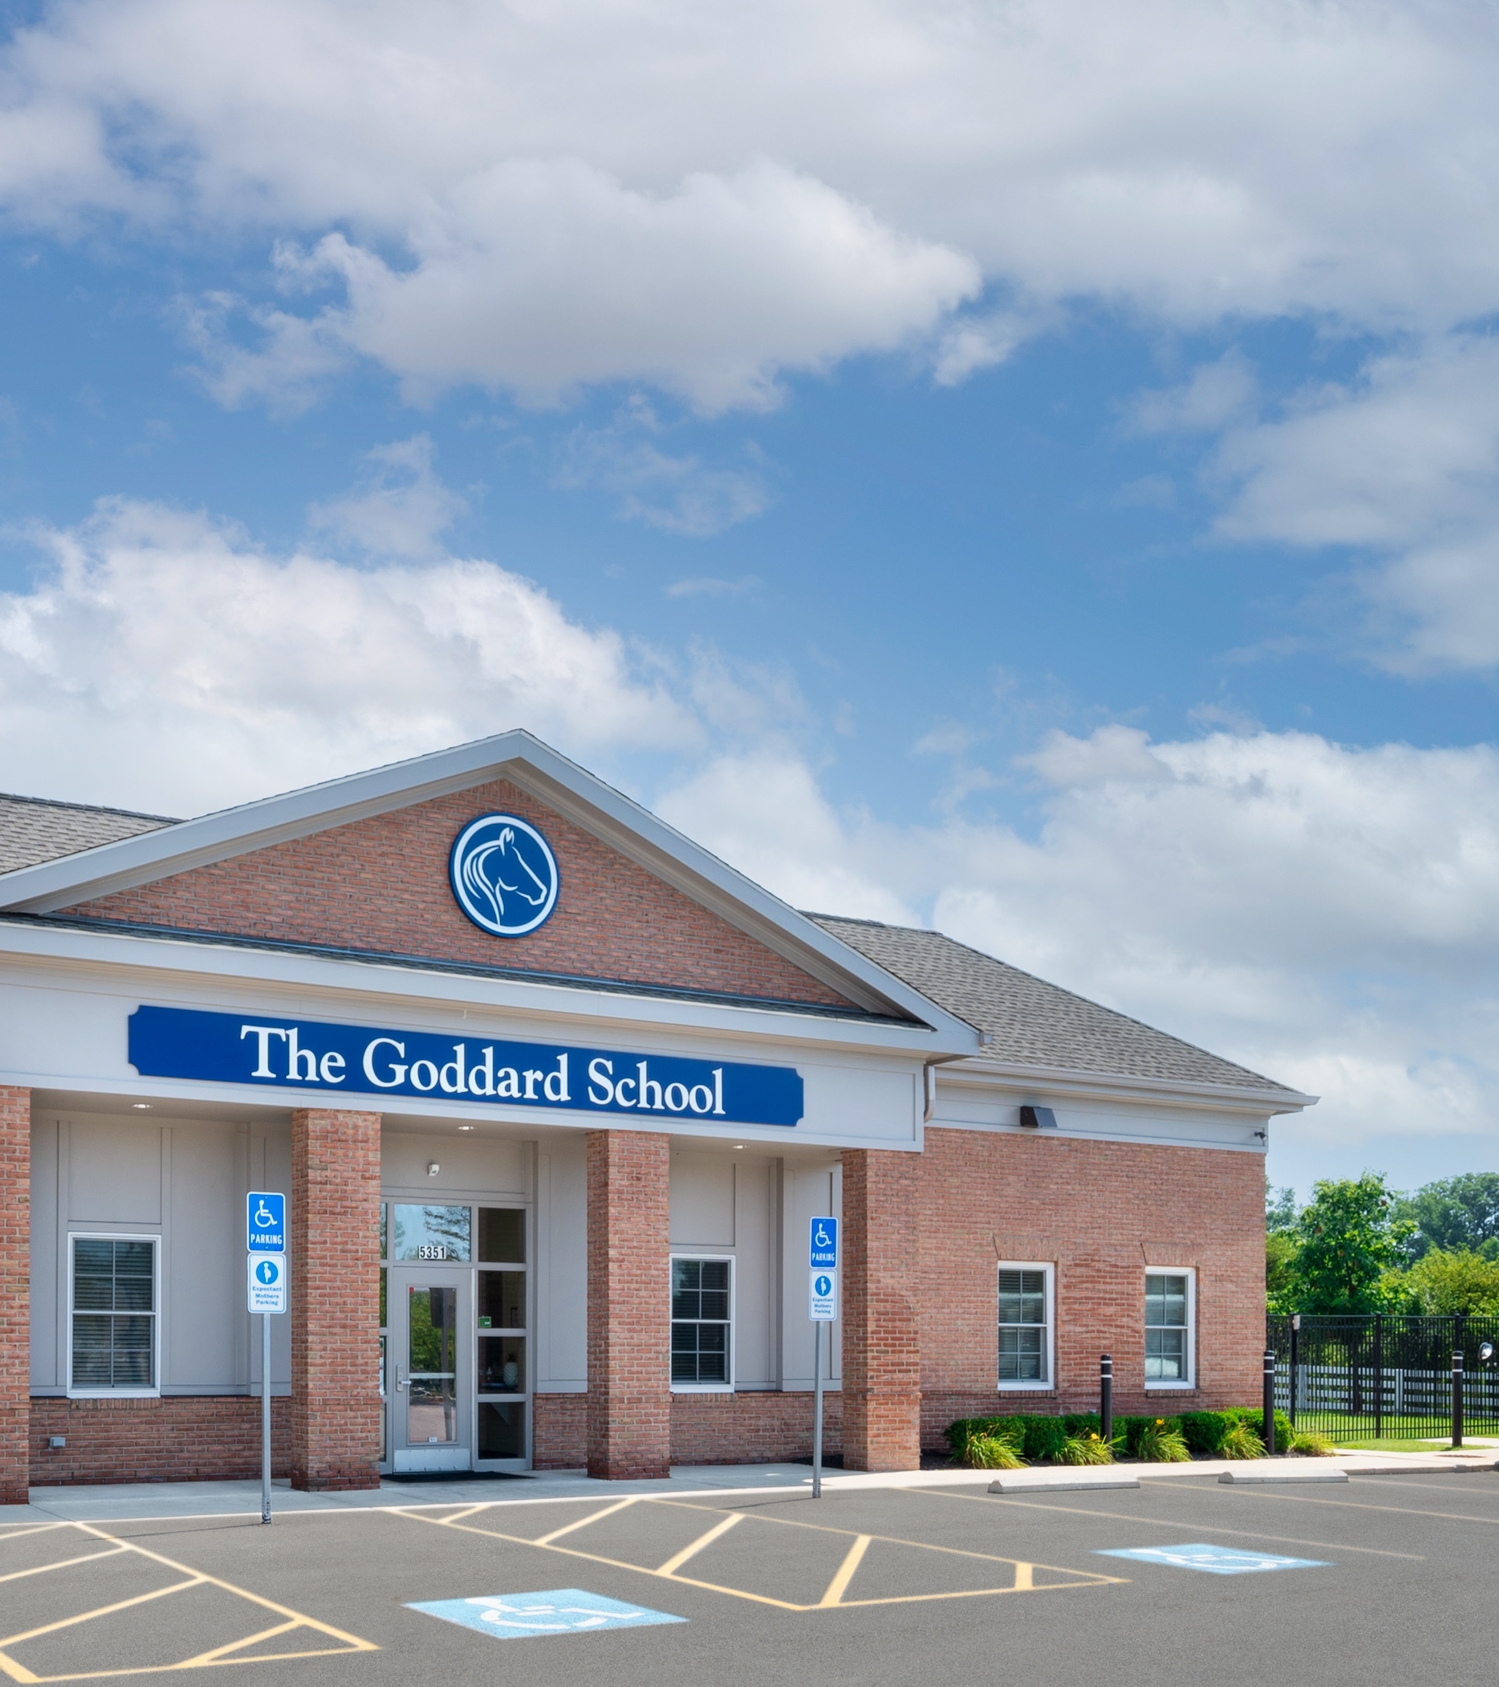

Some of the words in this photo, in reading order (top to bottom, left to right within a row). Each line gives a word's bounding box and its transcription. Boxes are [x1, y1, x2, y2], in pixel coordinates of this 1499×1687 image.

[240, 1024, 346, 1083] The
[362, 1037, 571, 1102] Goddard
[587, 1058, 726, 1115] School
[251, 1233, 282, 1245] PARKING
[419, 1246, 445, 1258] 5351
[811, 1252, 835, 1262] PARKING
